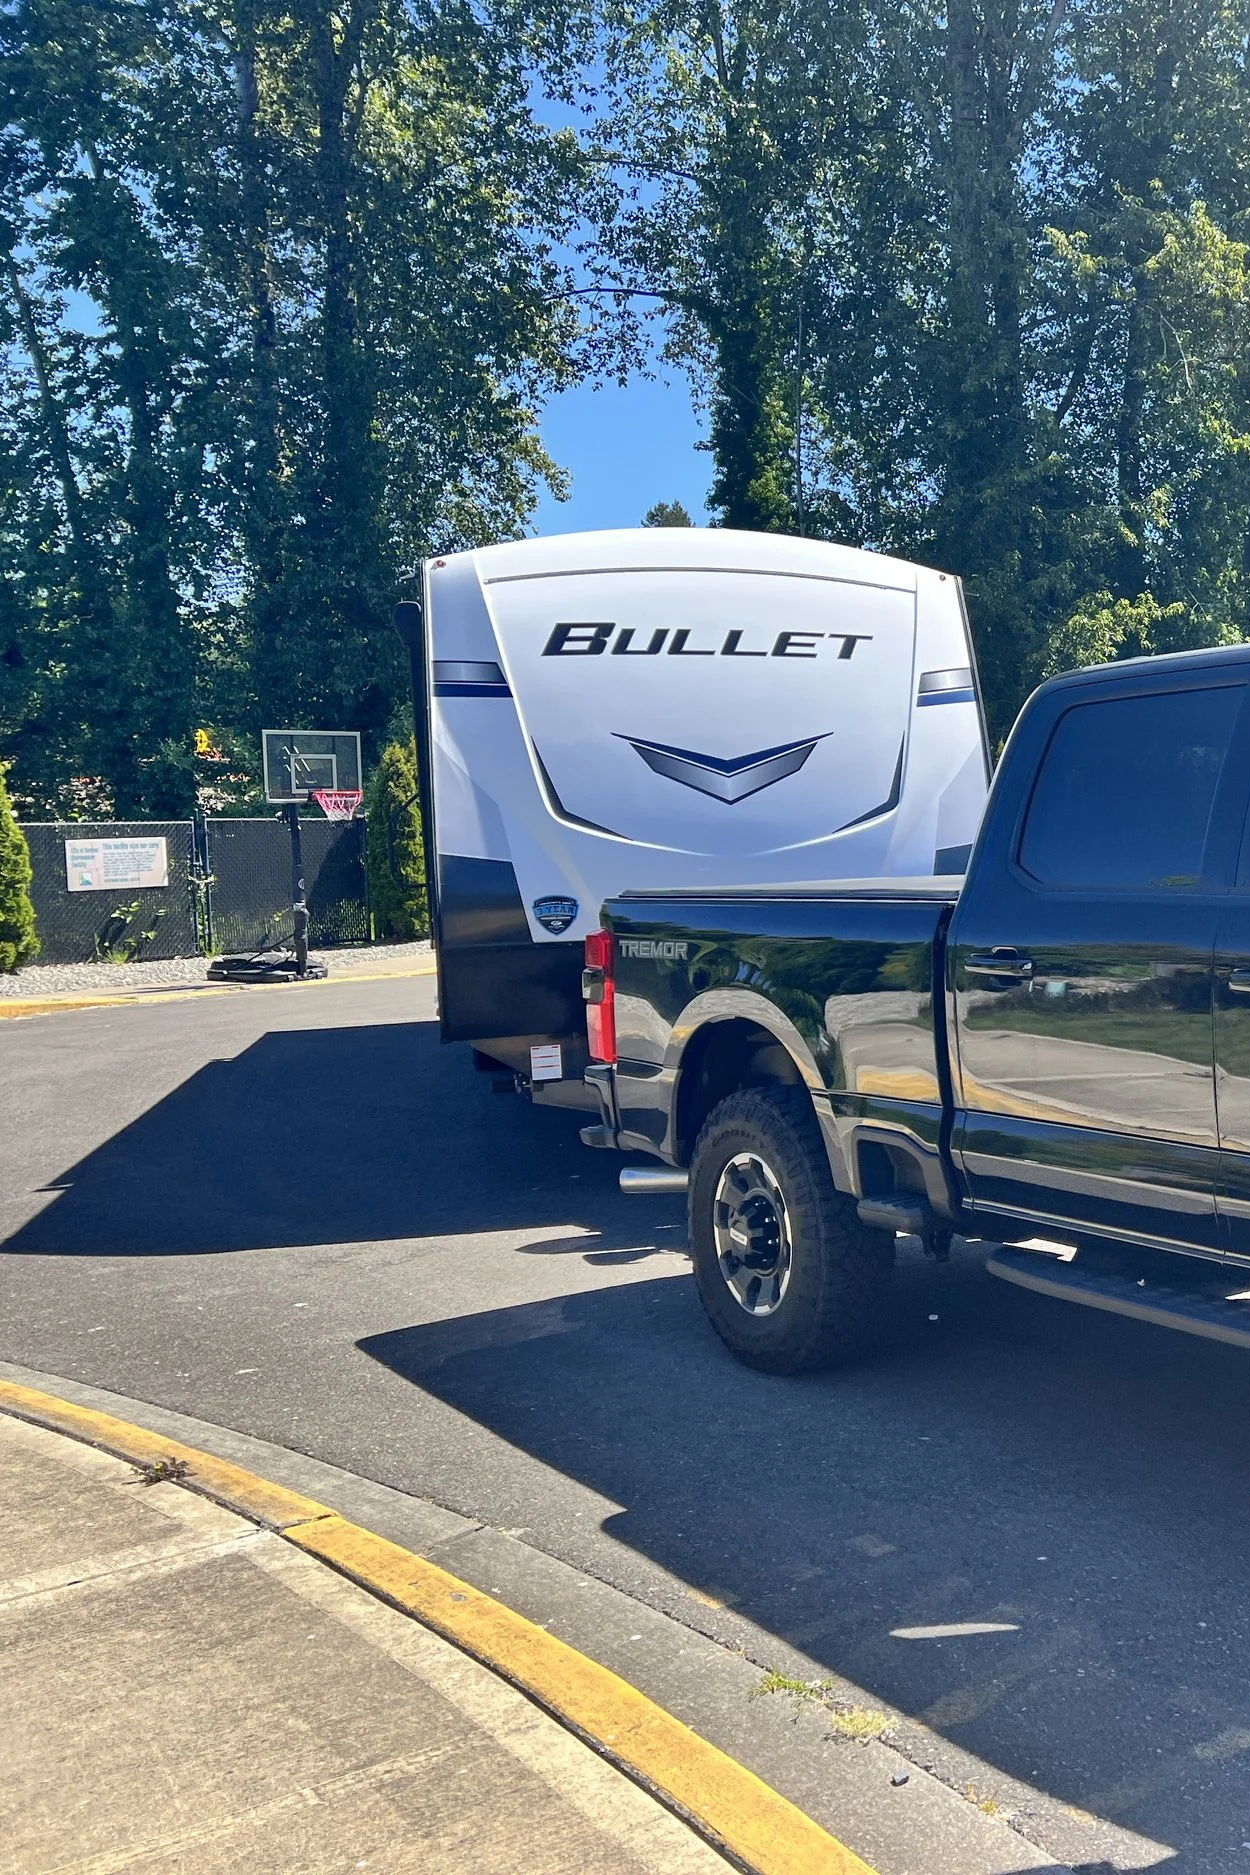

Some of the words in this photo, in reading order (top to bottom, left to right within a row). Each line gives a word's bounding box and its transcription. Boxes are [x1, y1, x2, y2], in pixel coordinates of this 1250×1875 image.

[541, 622, 873, 660] BULLET
[536, 908, 544, 916] 3
[546, 905, 575, 915] YEAR
[619, 940, 689, 960] TREMOR
